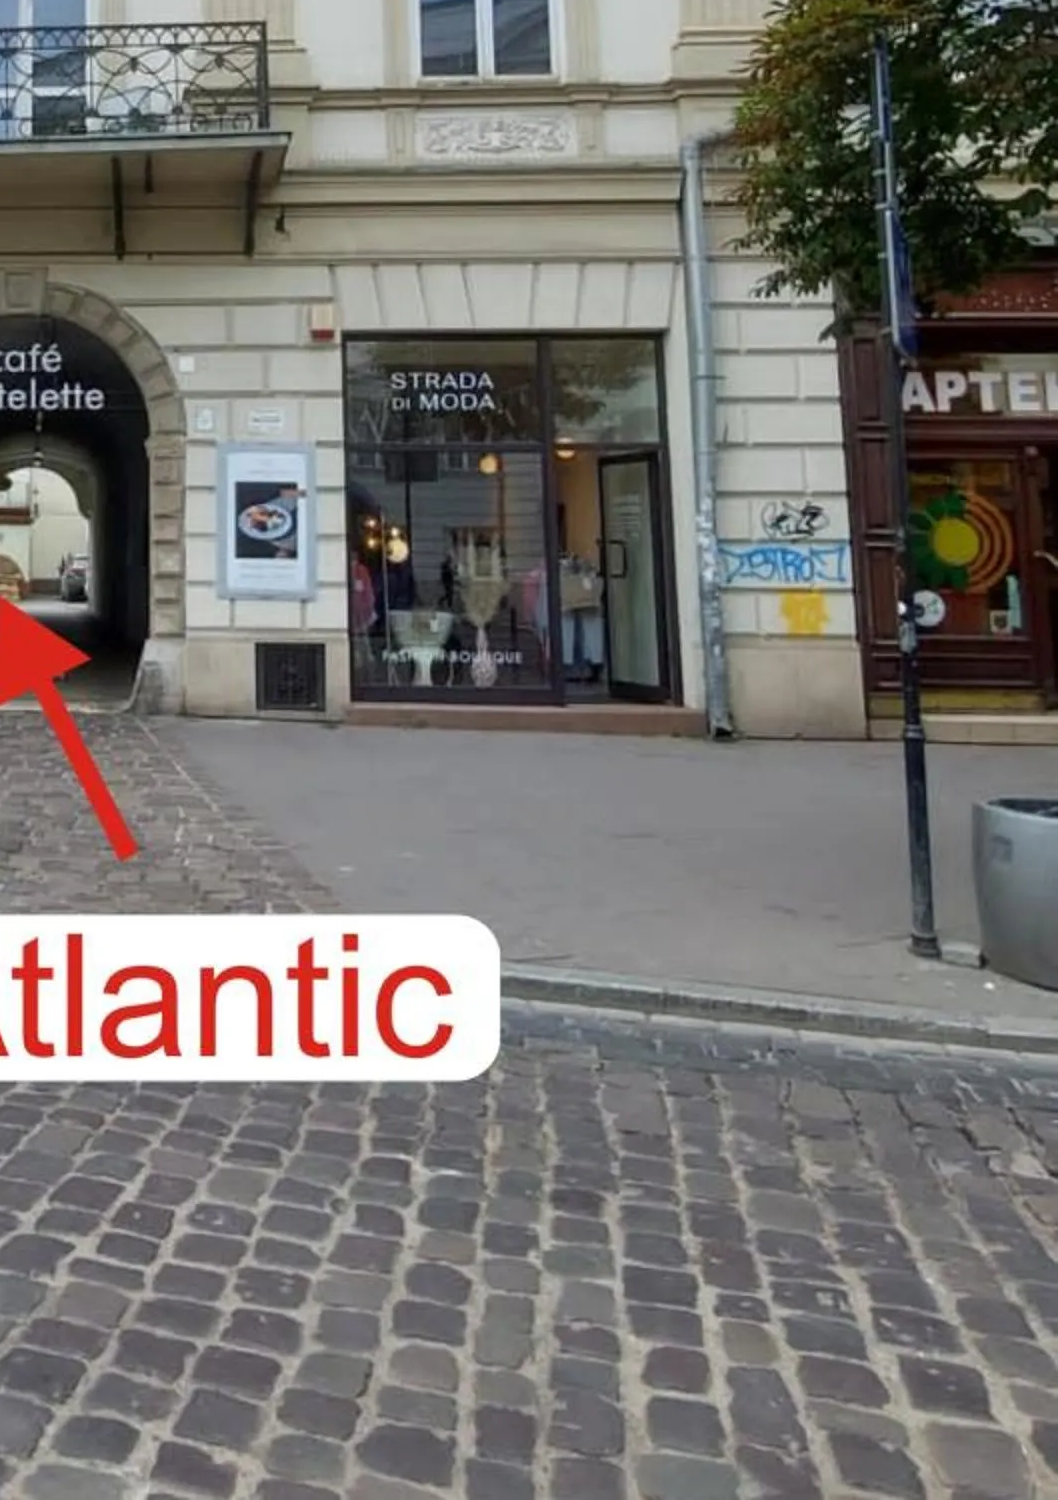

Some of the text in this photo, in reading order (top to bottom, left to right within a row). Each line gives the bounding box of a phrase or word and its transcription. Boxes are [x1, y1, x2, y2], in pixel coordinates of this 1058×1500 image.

[390, 371, 494, 390] STRADA
[392, 393, 496, 411] DI MODA
